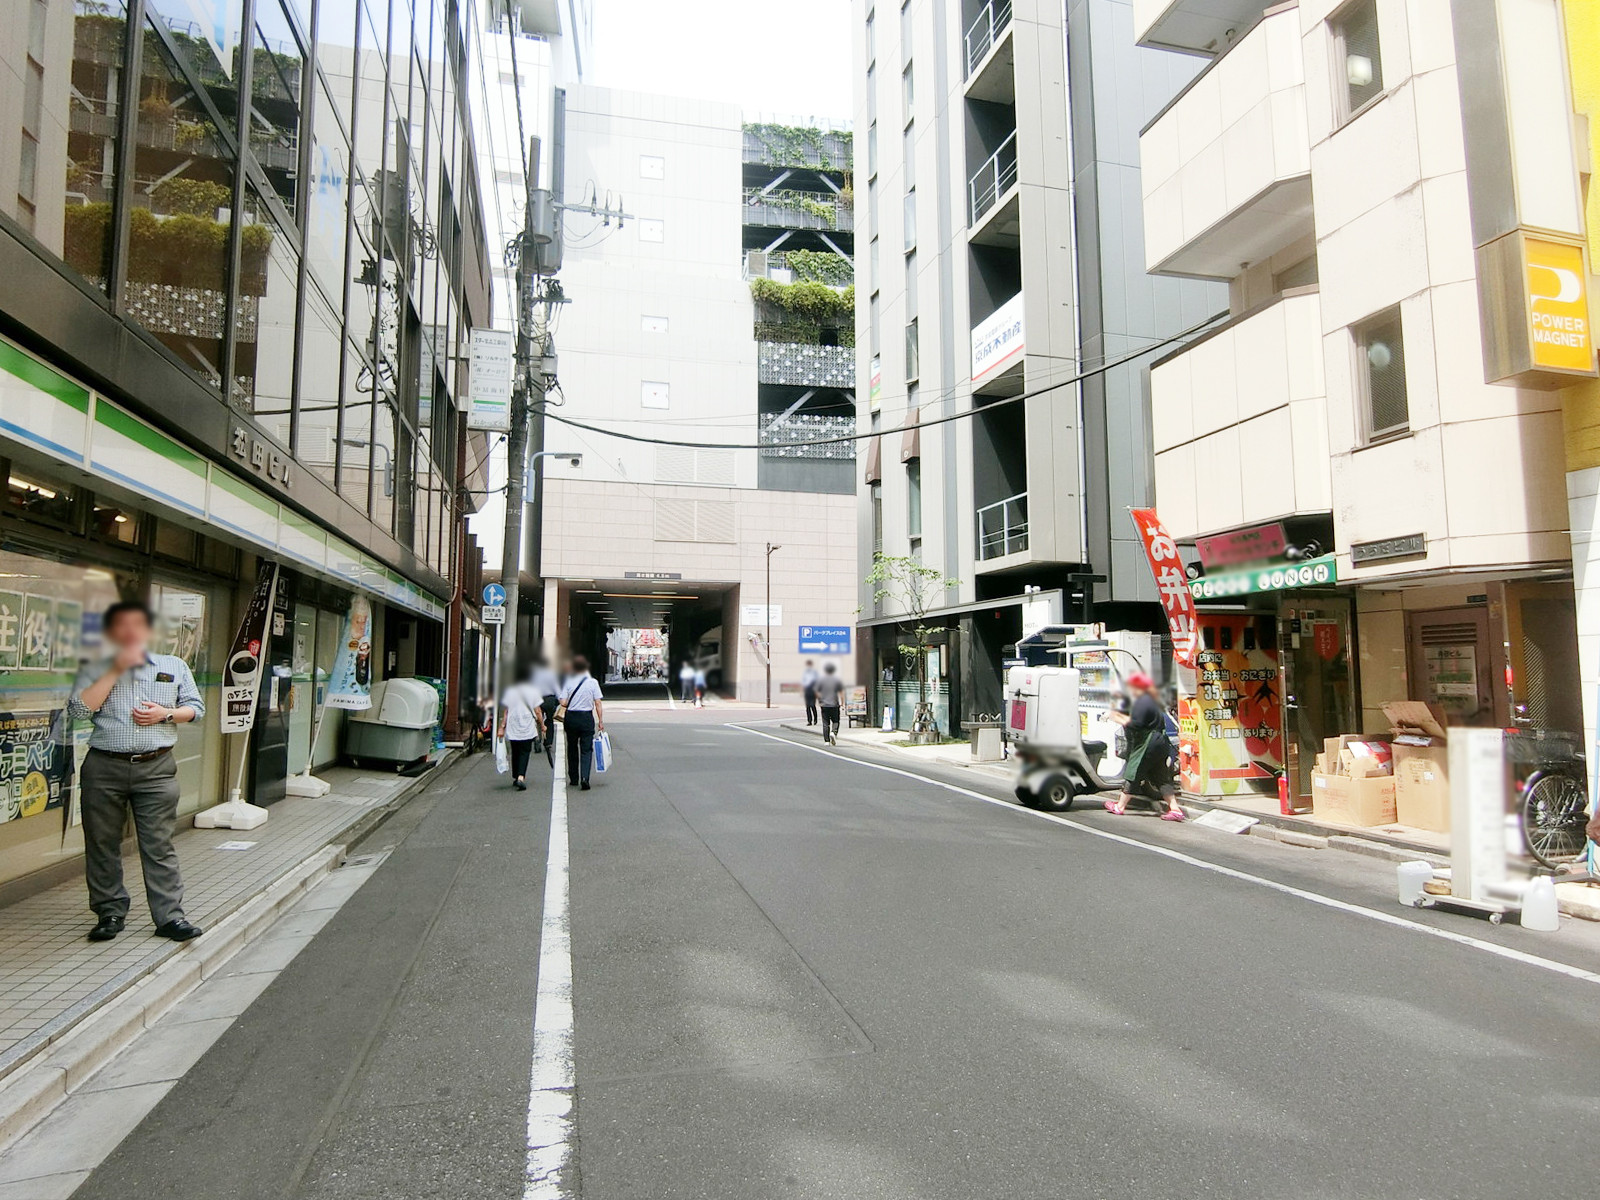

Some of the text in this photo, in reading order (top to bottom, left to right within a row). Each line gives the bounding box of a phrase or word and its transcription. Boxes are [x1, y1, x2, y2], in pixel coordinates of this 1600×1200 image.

[1532, 312, 1584, 332] POWER
[1533, 328, 1585, 348] MAGNET
[1145, 519, 1196, 660] お弁当
[1198, 652, 1223, 663] 店内に
[1202, 669, 1275, 681] お弁当・おにぎり
[1204, 684, 1220, 700] 35
[1204, 708, 1232, 720] お惣菜
[1208, 723, 1222, 739] 41
[1243, 728, 1275, 738] あります
